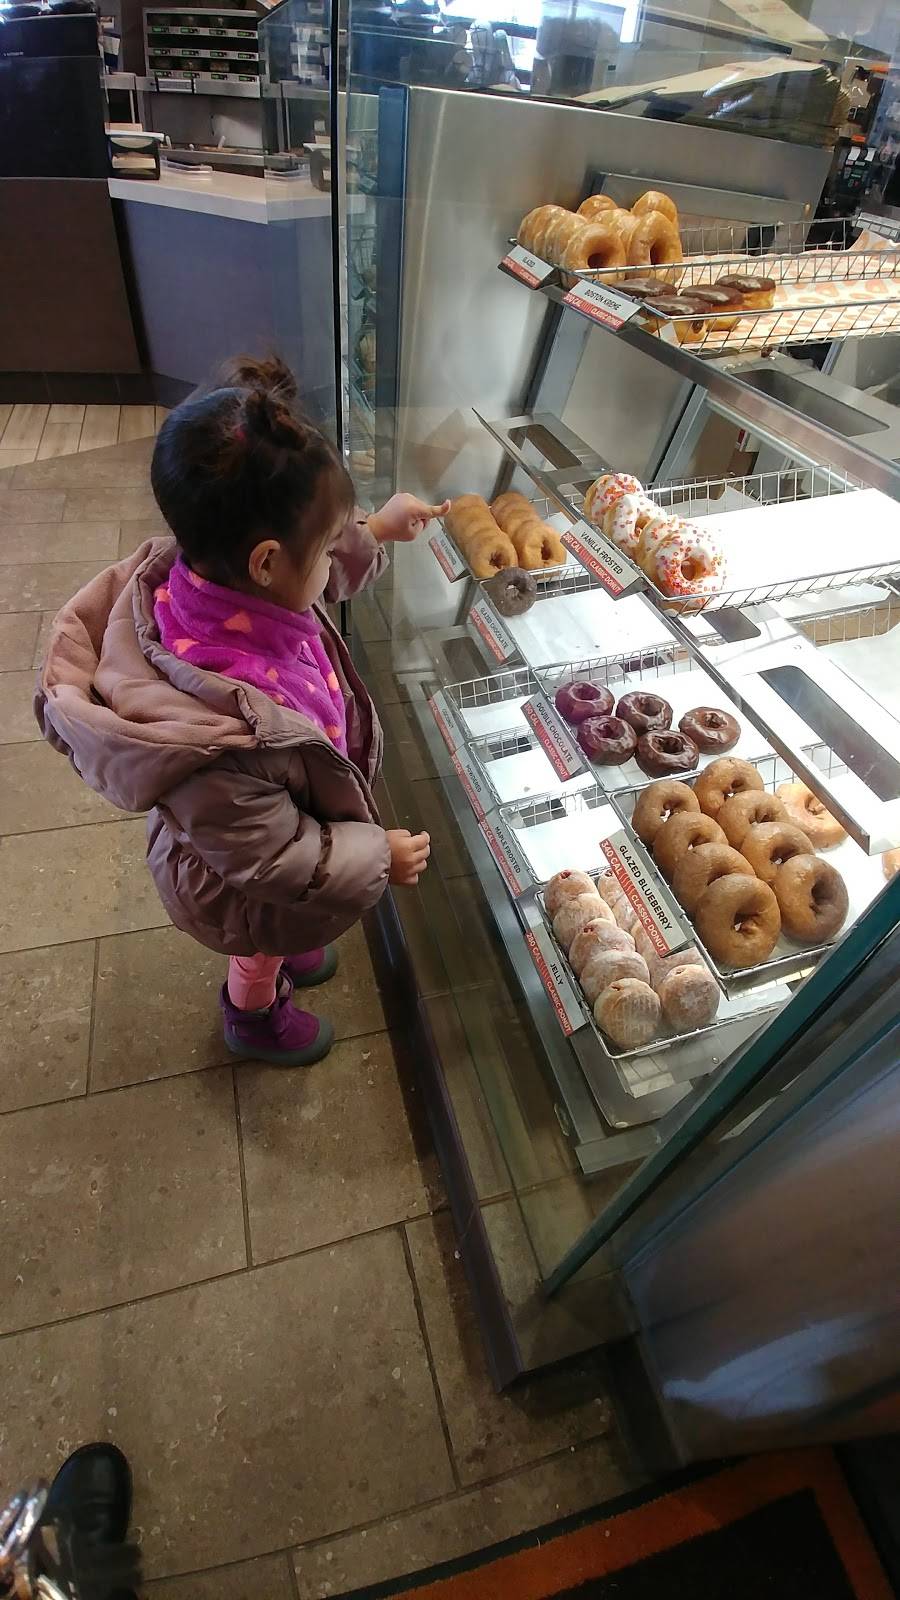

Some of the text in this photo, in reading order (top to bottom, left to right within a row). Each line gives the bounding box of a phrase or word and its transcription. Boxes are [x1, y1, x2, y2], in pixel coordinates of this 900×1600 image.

[583, 289, 606, 302] BOSTON
[601, 297, 623, 310] KREME
[569, 540, 583, 552] CAL
[588, 560, 608, 578] CLASSIC
[603, 575, 622, 593] DONUT
[579, 531, 624, 575] VANILLA FROSTED
[529, 712, 540, 726] CAL
[554, 758, 568, 778] DONUT
[535, 701, 573, 763] DOUBLE CHOCOLATE
[465, 763, 482, 794] POWDERED
[485, 829, 494, 842] CAL
[493, 825, 521, 874] MAPLE FROSTED
[600, 840, 666, 953] 340 CAL CLASSIC DONUT
[617, 844, 672, 932] GLAZED BLUEBERRY
[531, 946, 542, 963] CAL
[545, 980, 561, 1008] CLASSIC
[557, 1007, 571, 1032] DONUT
[549, 962, 564, 986] JELLY
